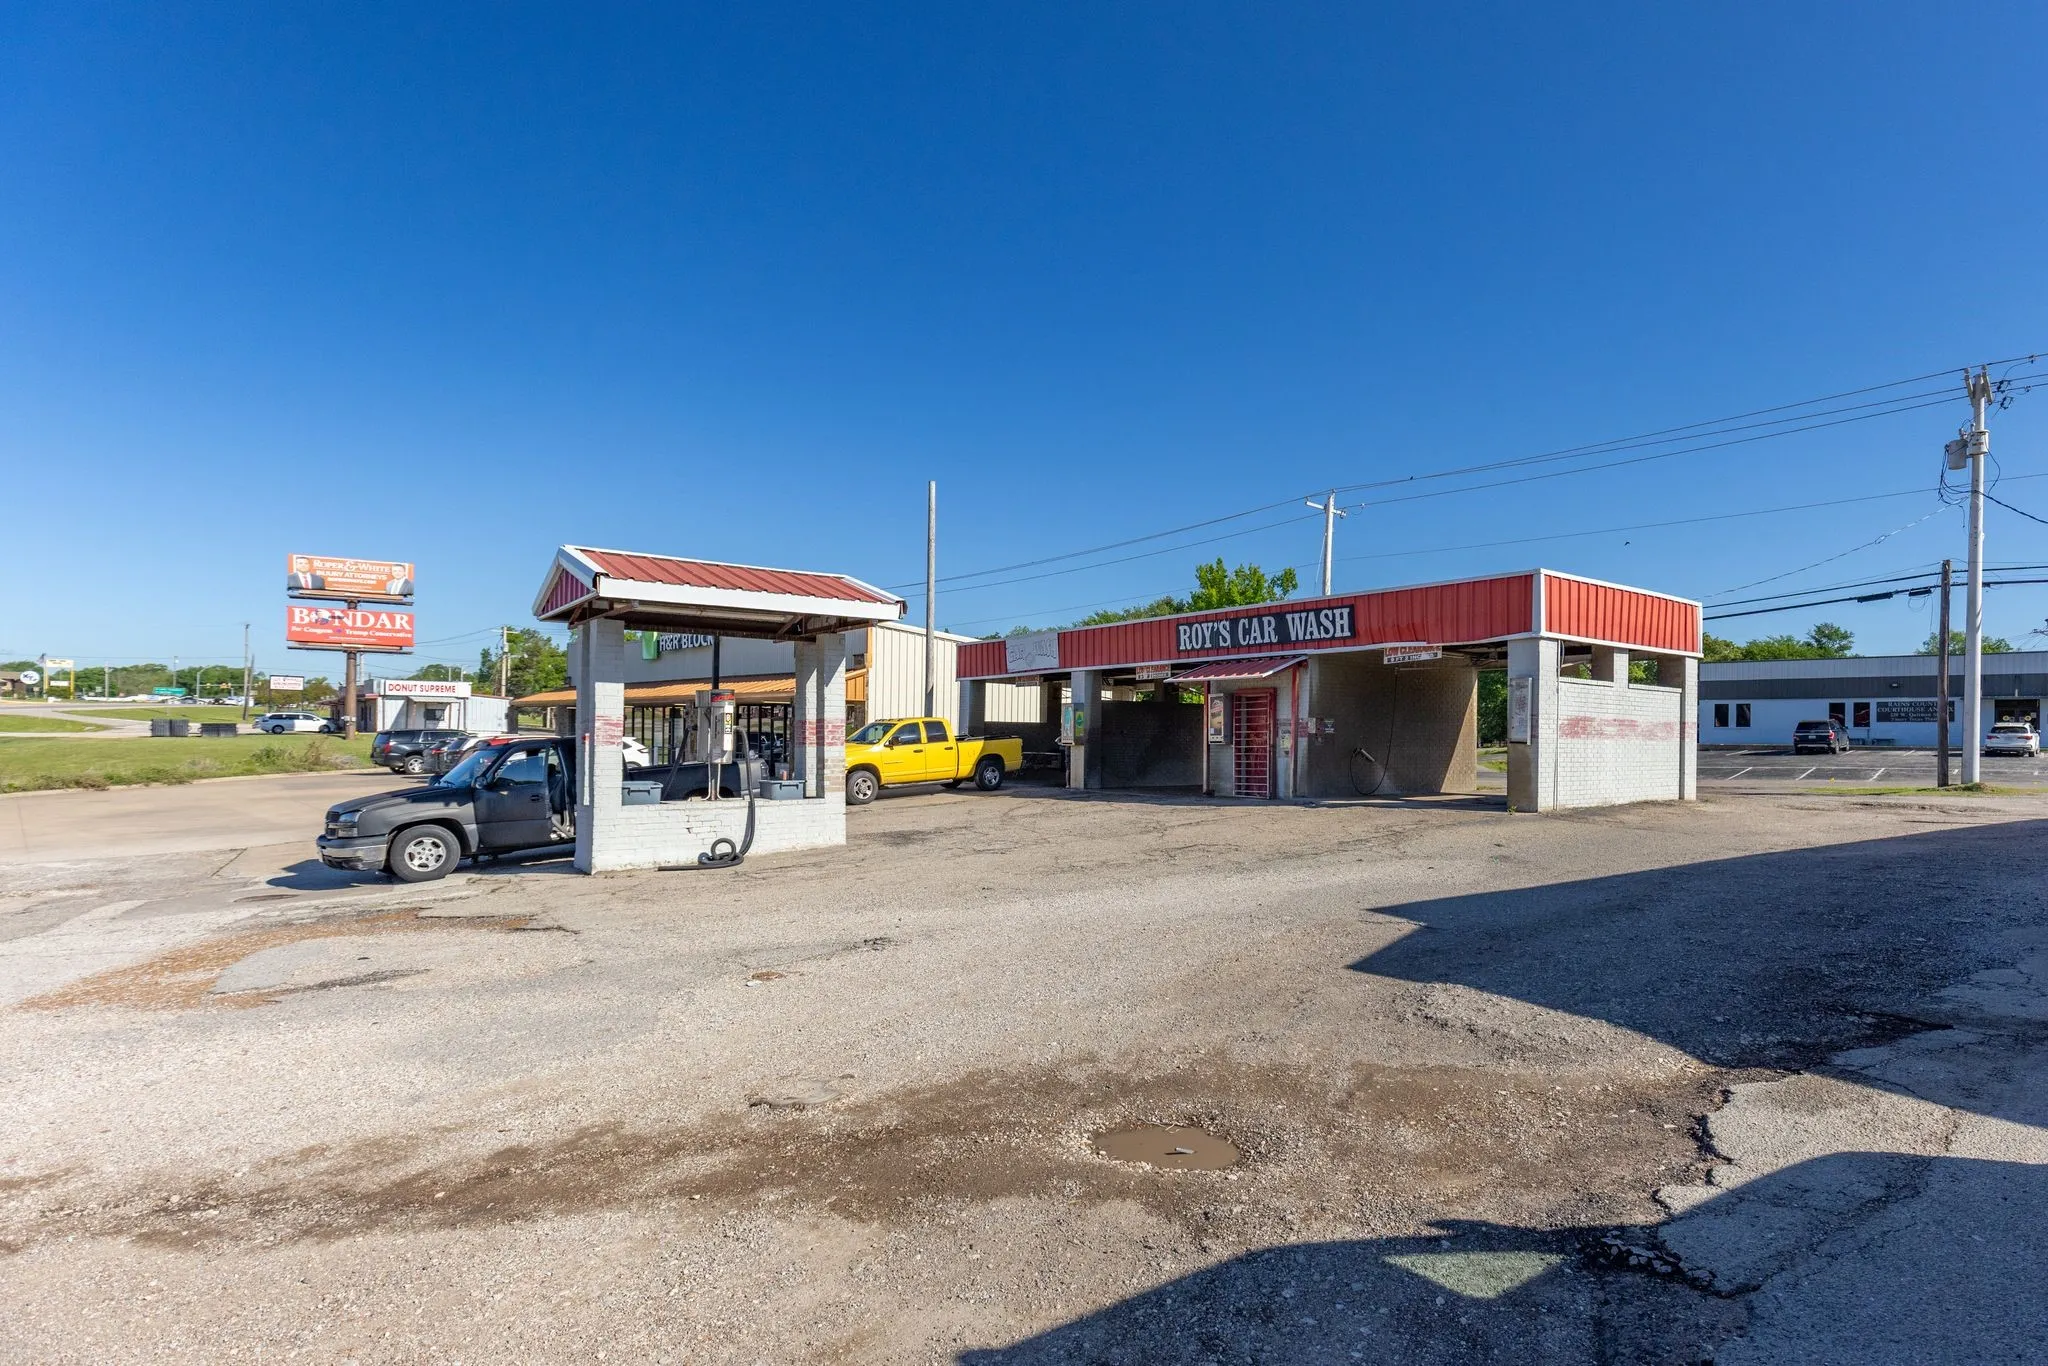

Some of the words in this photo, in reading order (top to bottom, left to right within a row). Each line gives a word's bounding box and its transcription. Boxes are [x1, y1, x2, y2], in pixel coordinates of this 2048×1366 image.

[358, 563, 392, 573] WHITE
[1179, 619, 1231, 650] ROY'S
[1238, 616, 1278, 646] CAR
[1285, 607, 1351, 641] WASH
[388, 683, 417, 692] DONUT
[419, 684, 456, 693] SUPREME
